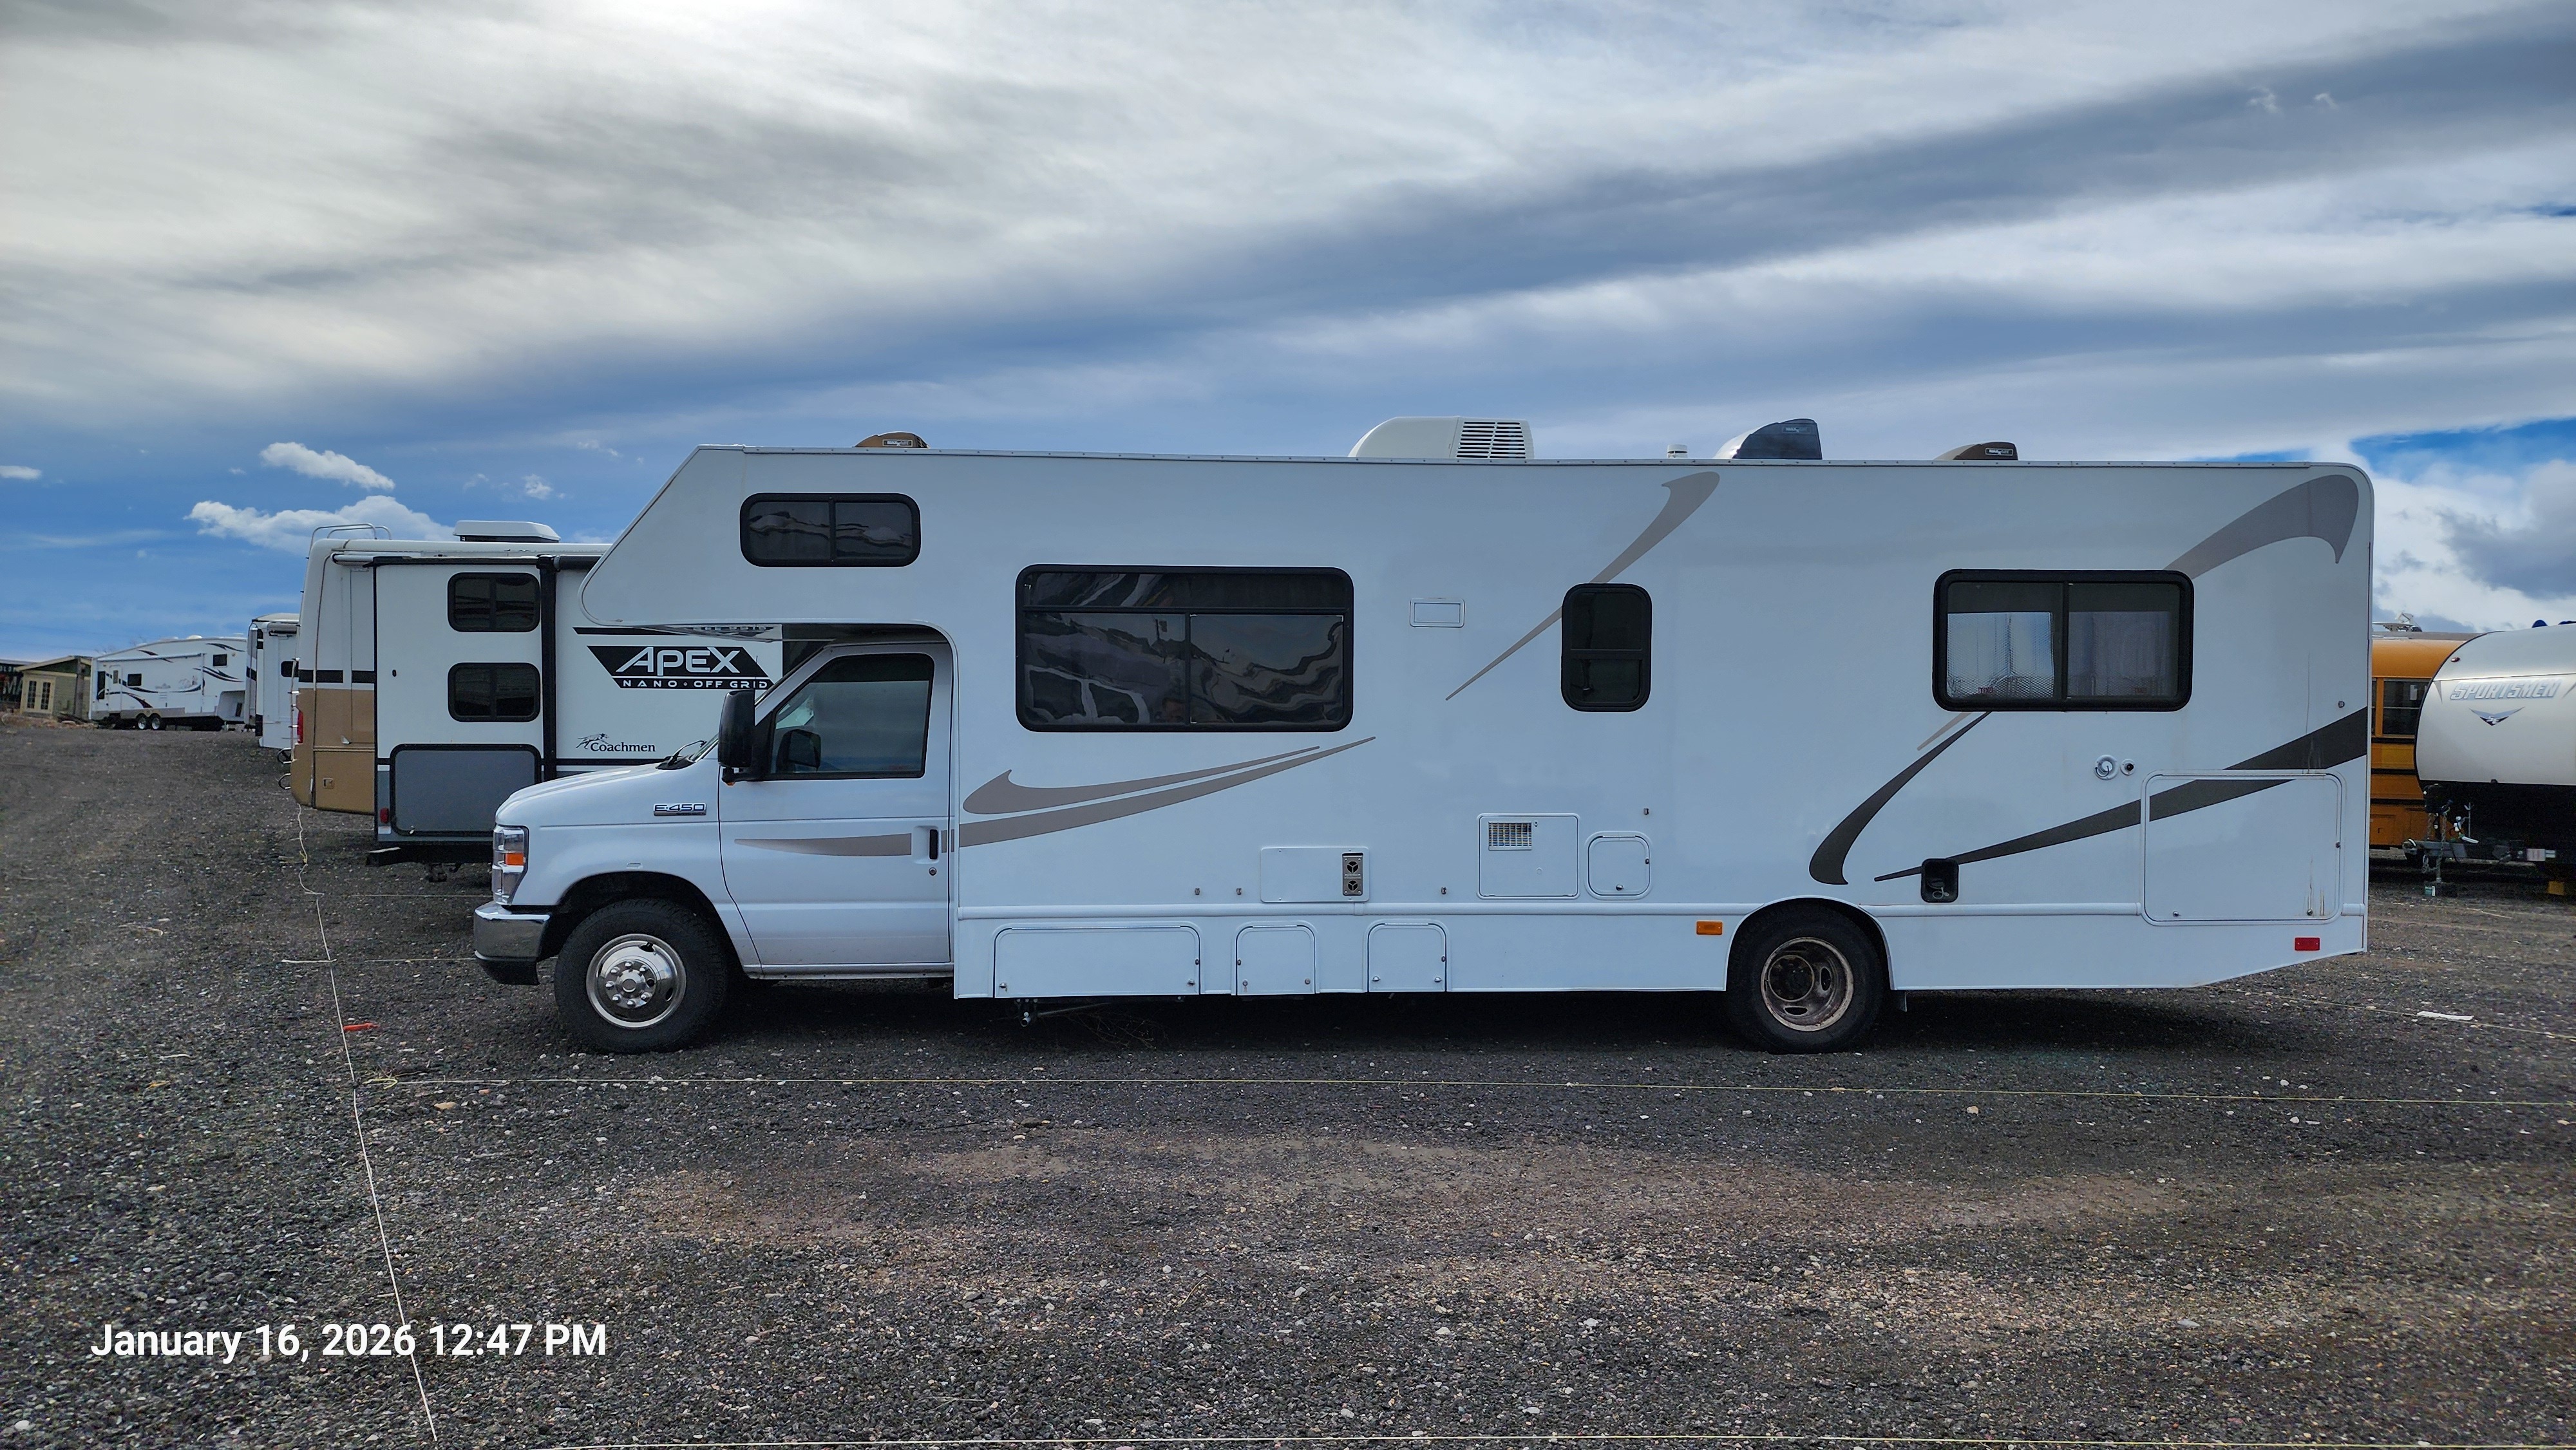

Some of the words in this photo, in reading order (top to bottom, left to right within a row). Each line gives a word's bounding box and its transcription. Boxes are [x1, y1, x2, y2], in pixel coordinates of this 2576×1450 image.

[615, 646, 741, 676] APEX
[623, 679, 677, 688] NANO
[2450, 679, 2562, 700] SPORTSMEN
[590, 742, 656, 752] Coachmen
